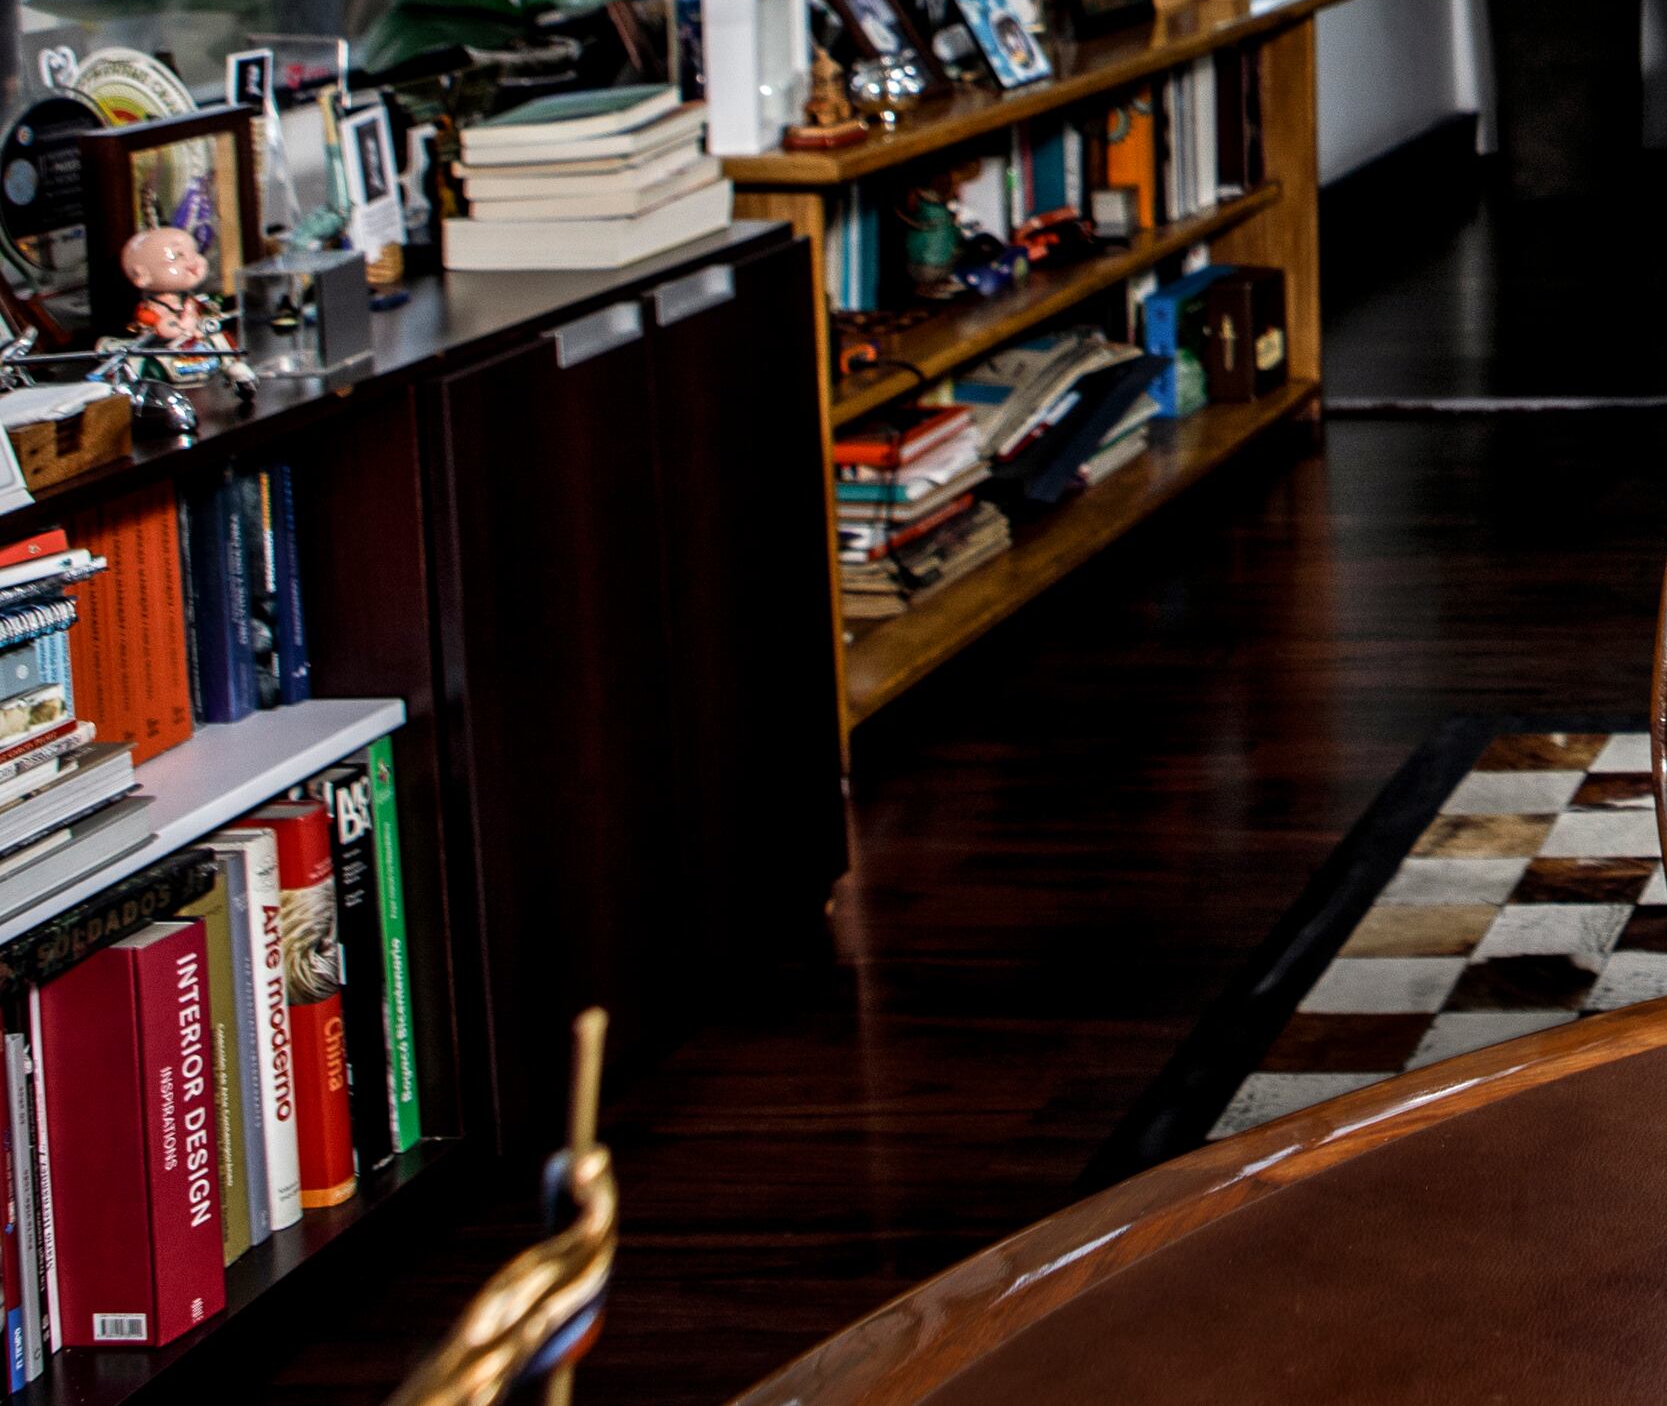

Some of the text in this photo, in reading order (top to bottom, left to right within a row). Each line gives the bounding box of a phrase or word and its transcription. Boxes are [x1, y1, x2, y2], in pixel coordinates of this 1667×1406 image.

[176, 953, 211, 1228] INTERIOR DESIGN
[262, 905, 291, 1122] Arte moderno
[323, 1016, 344, 1092] China
[160, 1067, 176, 1171] INSPIRATIONS
